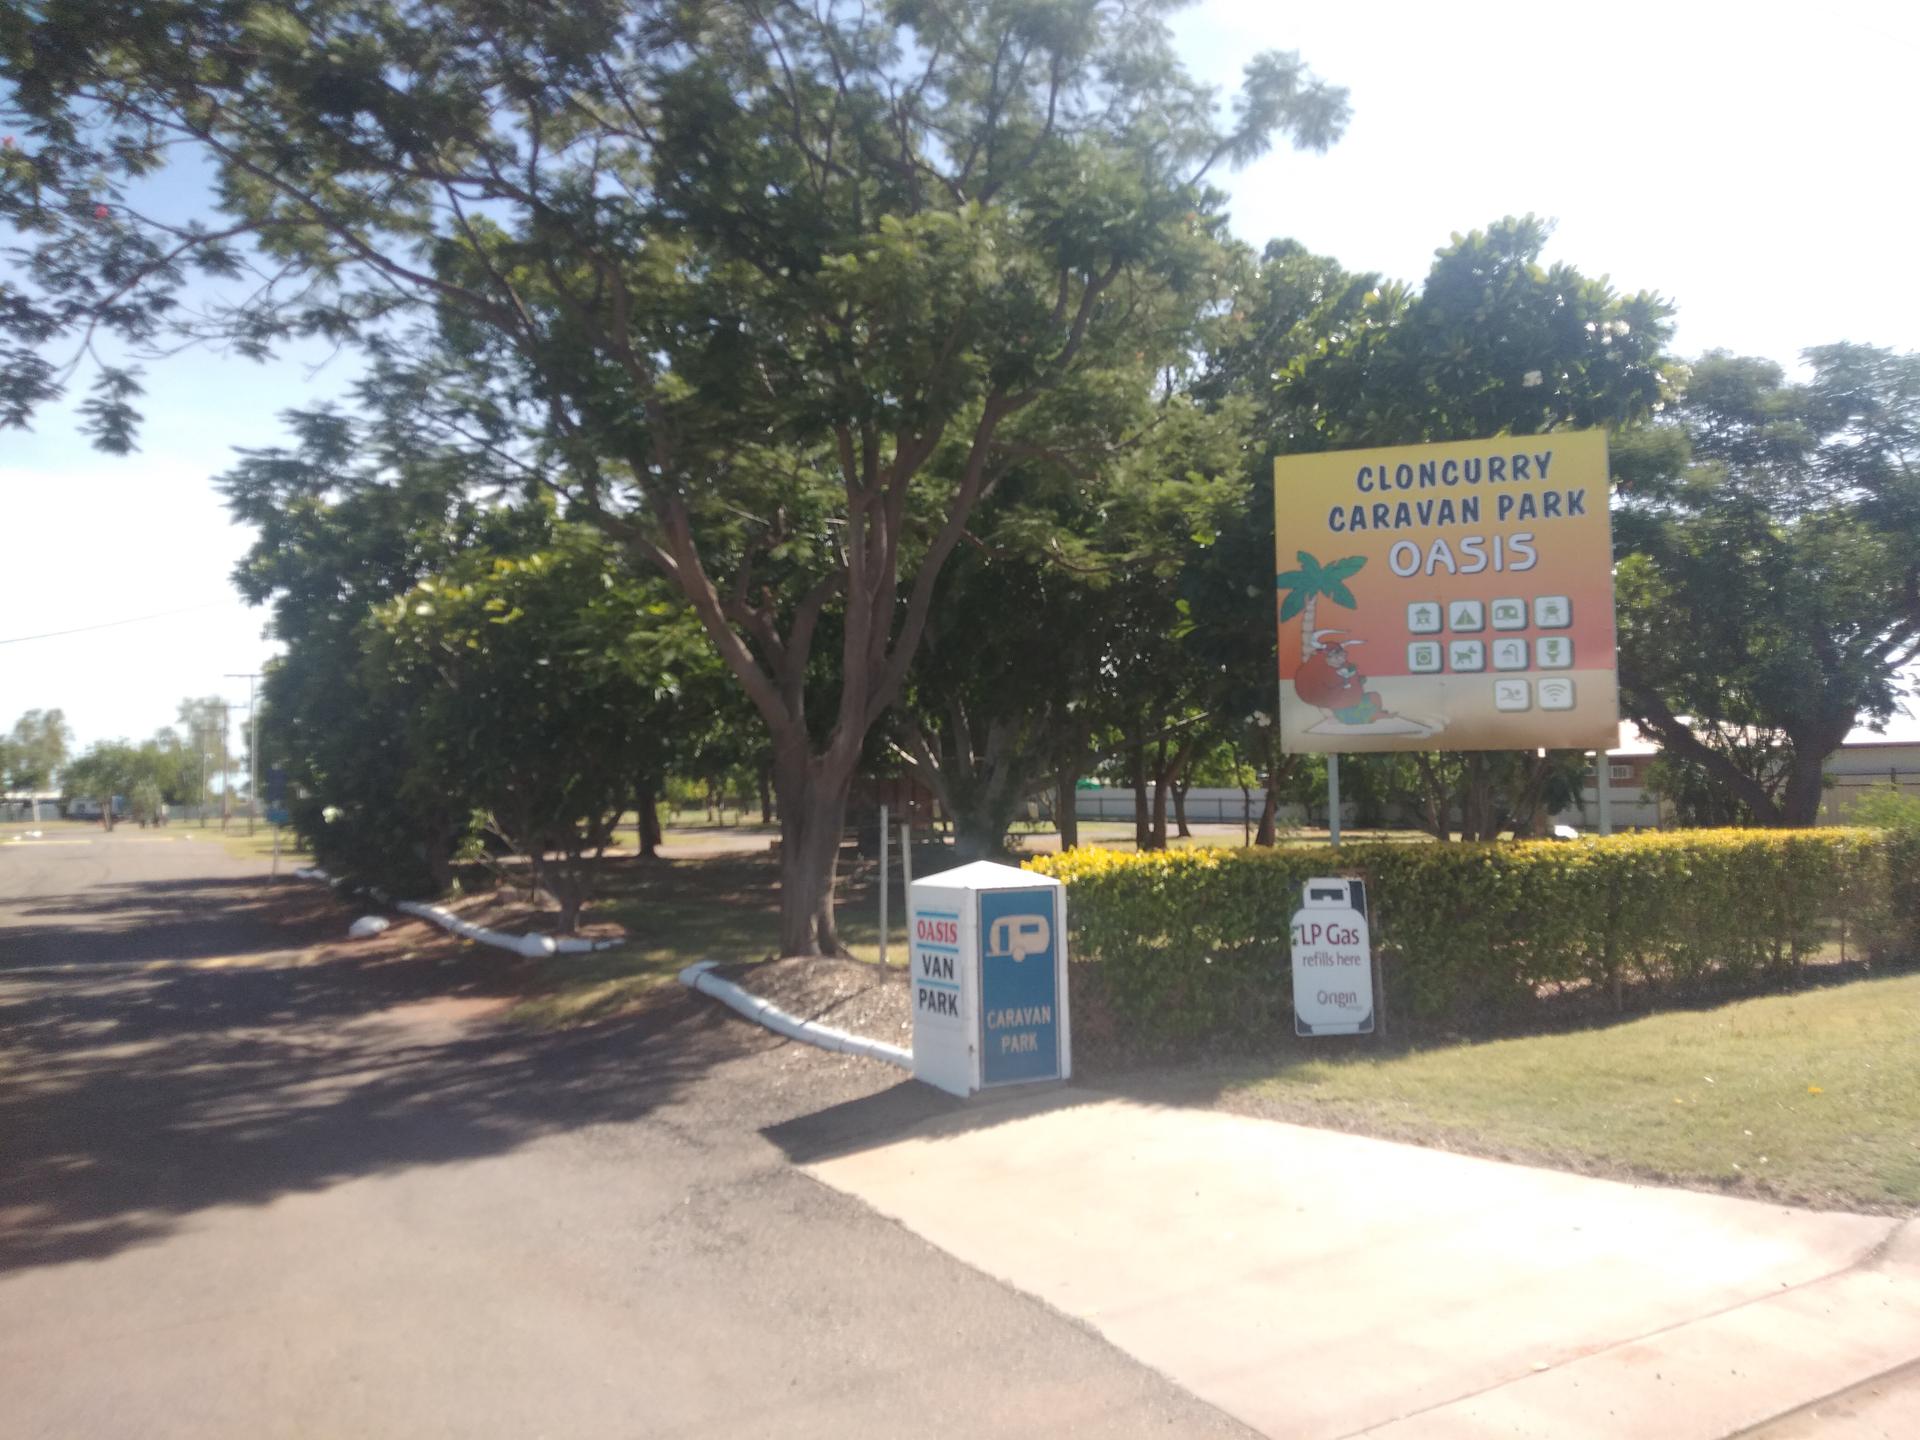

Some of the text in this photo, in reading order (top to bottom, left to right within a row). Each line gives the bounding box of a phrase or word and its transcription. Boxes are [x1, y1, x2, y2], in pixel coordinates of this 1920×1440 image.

[1357, 451, 1552, 493] CLONCURRY
[1328, 489, 1586, 532] CARAVAN PARK
[1388, 532, 1538, 577] OASIS
[916, 919, 958, 945] OASIS
[1300, 923, 1360, 946] LP Gas
[922, 955, 954, 980] VAN
[1302, 952, 1361, 967] refills here
[919, 988, 958, 1017] PARK
[1316, 990, 1357, 1008] Origin
[987, 1005, 1051, 1030] CARAVAN
[1001, 1033, 1038, 1054] PARK
